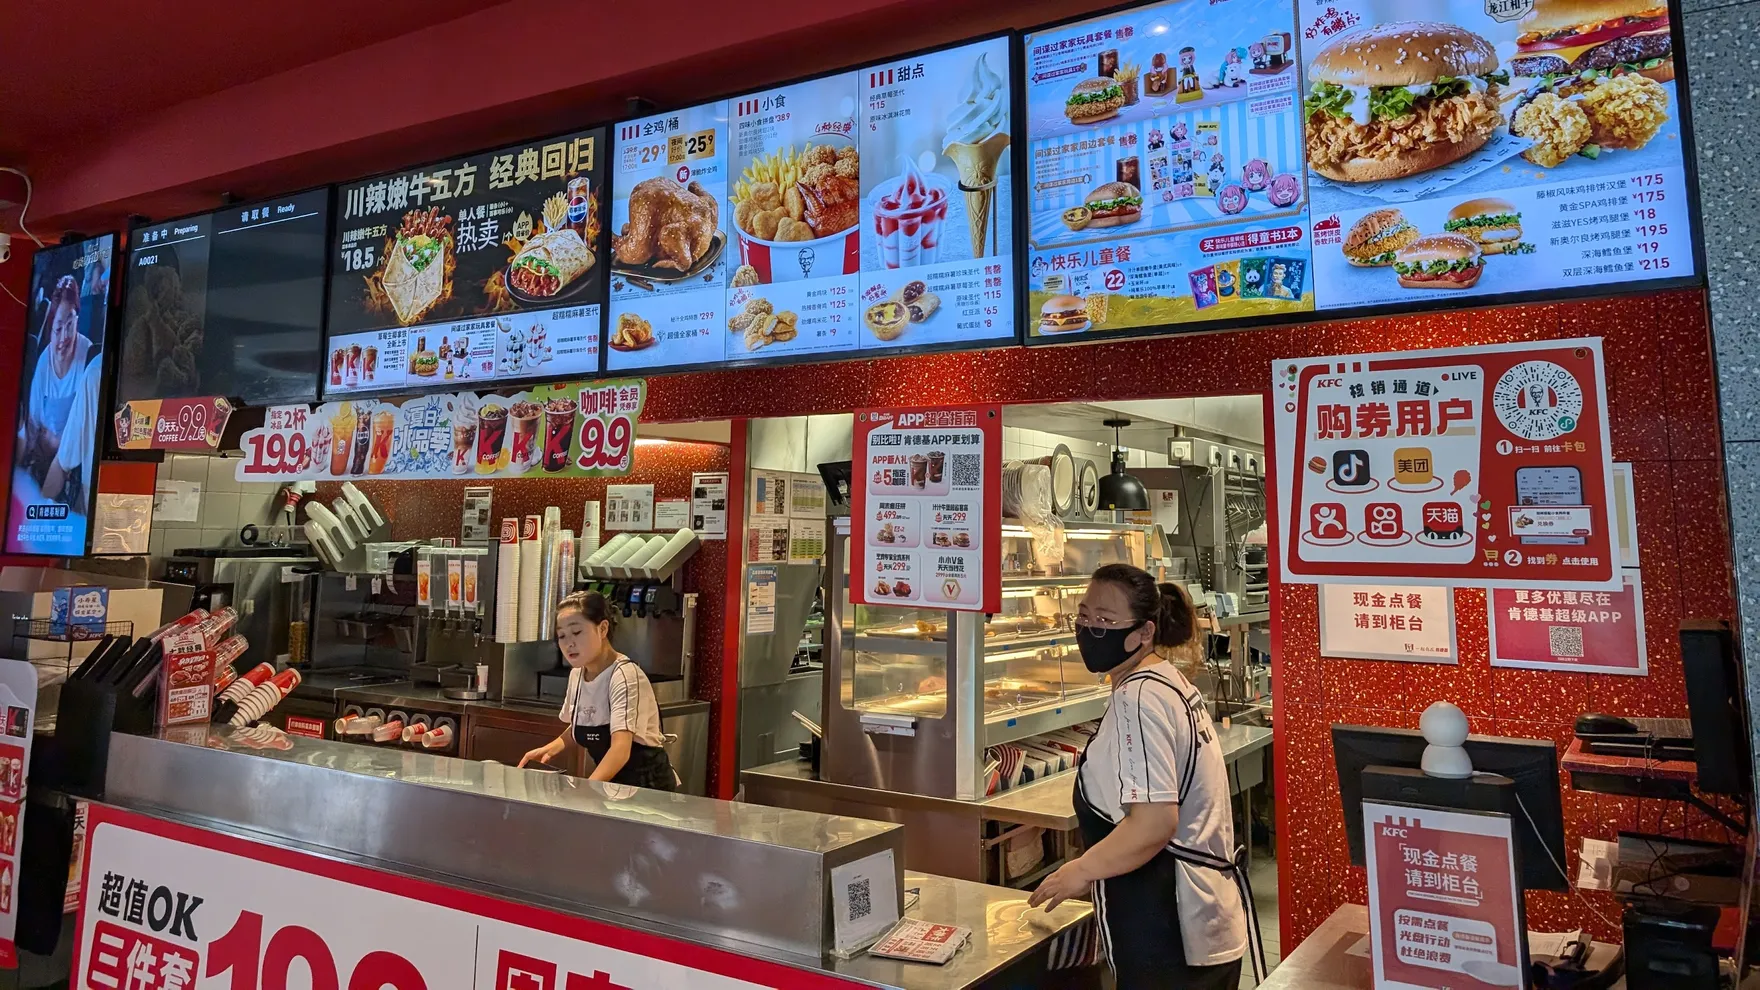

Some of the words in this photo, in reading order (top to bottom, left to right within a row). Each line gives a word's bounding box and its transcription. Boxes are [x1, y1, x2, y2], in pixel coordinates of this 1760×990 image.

[1033, 29, 1112, 55] 间谍过家家玩具套餐
[1115, 26, 1134, 39] 售罄
[897, 63, 925, 82] 甜点
[762, 94, 786, 111] 小食
[869, 89, 905, 102] 经典草莓圣代
[738, 116, 775, 130] 四味小食拼盘
[869, 109, 911, 122] 原味冰淇淋花筒
[643, 117, 679, 136] 全鸡/桶
[869, 123, 877, 132] ¥6
[1034, 136, 1115, 158] 间谍过家家周边套餐
[1119, 134, 1138, 148] 售罄
[344, 162, 477, 220] 川辣嫩牛五方
[489, 137, 595, 189] 经典回归
[1536, 180, 1627, 199] 藤椒风味鸡排饼汉堡
[1631, 173, 1664, 188] ¥17.5
[1559, 195, 1629, 212] 黄金SPA鸡排堡
[1632, 190, 1665, 203] ¥17.5
[241, 207, 270, 222] 请取餐
[277, 203, 295, 214] Ready
[458, 205, 486, 221] 单人餐
[1551, 212, 1630, 229] 滋滋YES烤鸡腿堡
[1634, 208, 1656, 220] ¥18
[142, 229, 168, 243] 准备中
[174, 224, 199, 236] Preparing
[342, 224, 387, 243] 川辣嫩牛五方
[517, 220, 530, 230] APP
[456, 218, 499, 253] 热卖
[1203, 239, 1215, 250] 买
[1247, 228, 1299, 246] 得童书1本
[1550, 229, 1631, 246] 新奥尔良烤鸡腿堡
[1635, 224, 1668, 237] ¥19.5
[341, 247, 374, 271] ¥18.5
[1051, 245, 1131, 272] 快乐儿童餐
[1581, 245, 1633, 259] 深海鳕鱼堡
[1637, 241, 1659, 254] ¥19
[138, 254, 158, 267] A0021
[1562, 262, 1634, 277] 双层深海鳕鱼堡
[1638, 257, 1670, 271] ¥21.5
[984, 265, 1002, 276] 售罄
[984, 278, 1002, 288] 售罄
[962, 308, 981, 316] 红豆派
[829, 328, 837, 337] ¥9
[983, 319, 992, 328] ¥8
[1452, 371, 1477, 381] LIVE
[1316, 378, 1343, 389] KFC
[1349, 379, 1432, 398] 核销通道
[580, 388, 617, 415] 咖啡
[619, 387, 639, 401] 会员
[271, 410, 282, 419] 指定
[284, 408, 307, 430] 2杯
[898, 410, 977, 427] APP超省指南
[1316, 398, 1474, 440] 购券用户
[1528, 408, 1549, 416] KFC
[270, 421, 282, 430] 冰品
[158, 433, 178, 443] COFFEE
[871, 434, 901, 446] 别比啦!
[904, 434, 980, 446] 肯德基APP更划算
[1515, 445, 1540, 454] 扫一扫
[872, 454, 908, 465] APP新人礼
[1397, 459, 1429, 473] 美团
[1426, 508, 1459, 523] 天猫
[1527, 553, 1558, 565] 找到券
[1562, 556, 1599, 566] 点击使用
[1352, 592, 1423, 610] 现金点餐
[1514, 589, 1612, 607] 更多优惠尽在
[1354, 613, 1424, 632] 请到柜台
[1507, 607, 1622, 624] 肯德基超级APP
[1381, 826, 1408, 839] KFC
[98, 871, 204, 942] 超值OK
[1398, 914, 1449, 932] 按需点餐
[1400, 930, 1450, 948] 光盘行动
[96, 934, 194, 990] 三件套
[1401, 946, 1452, 964] 杜绝浪费
